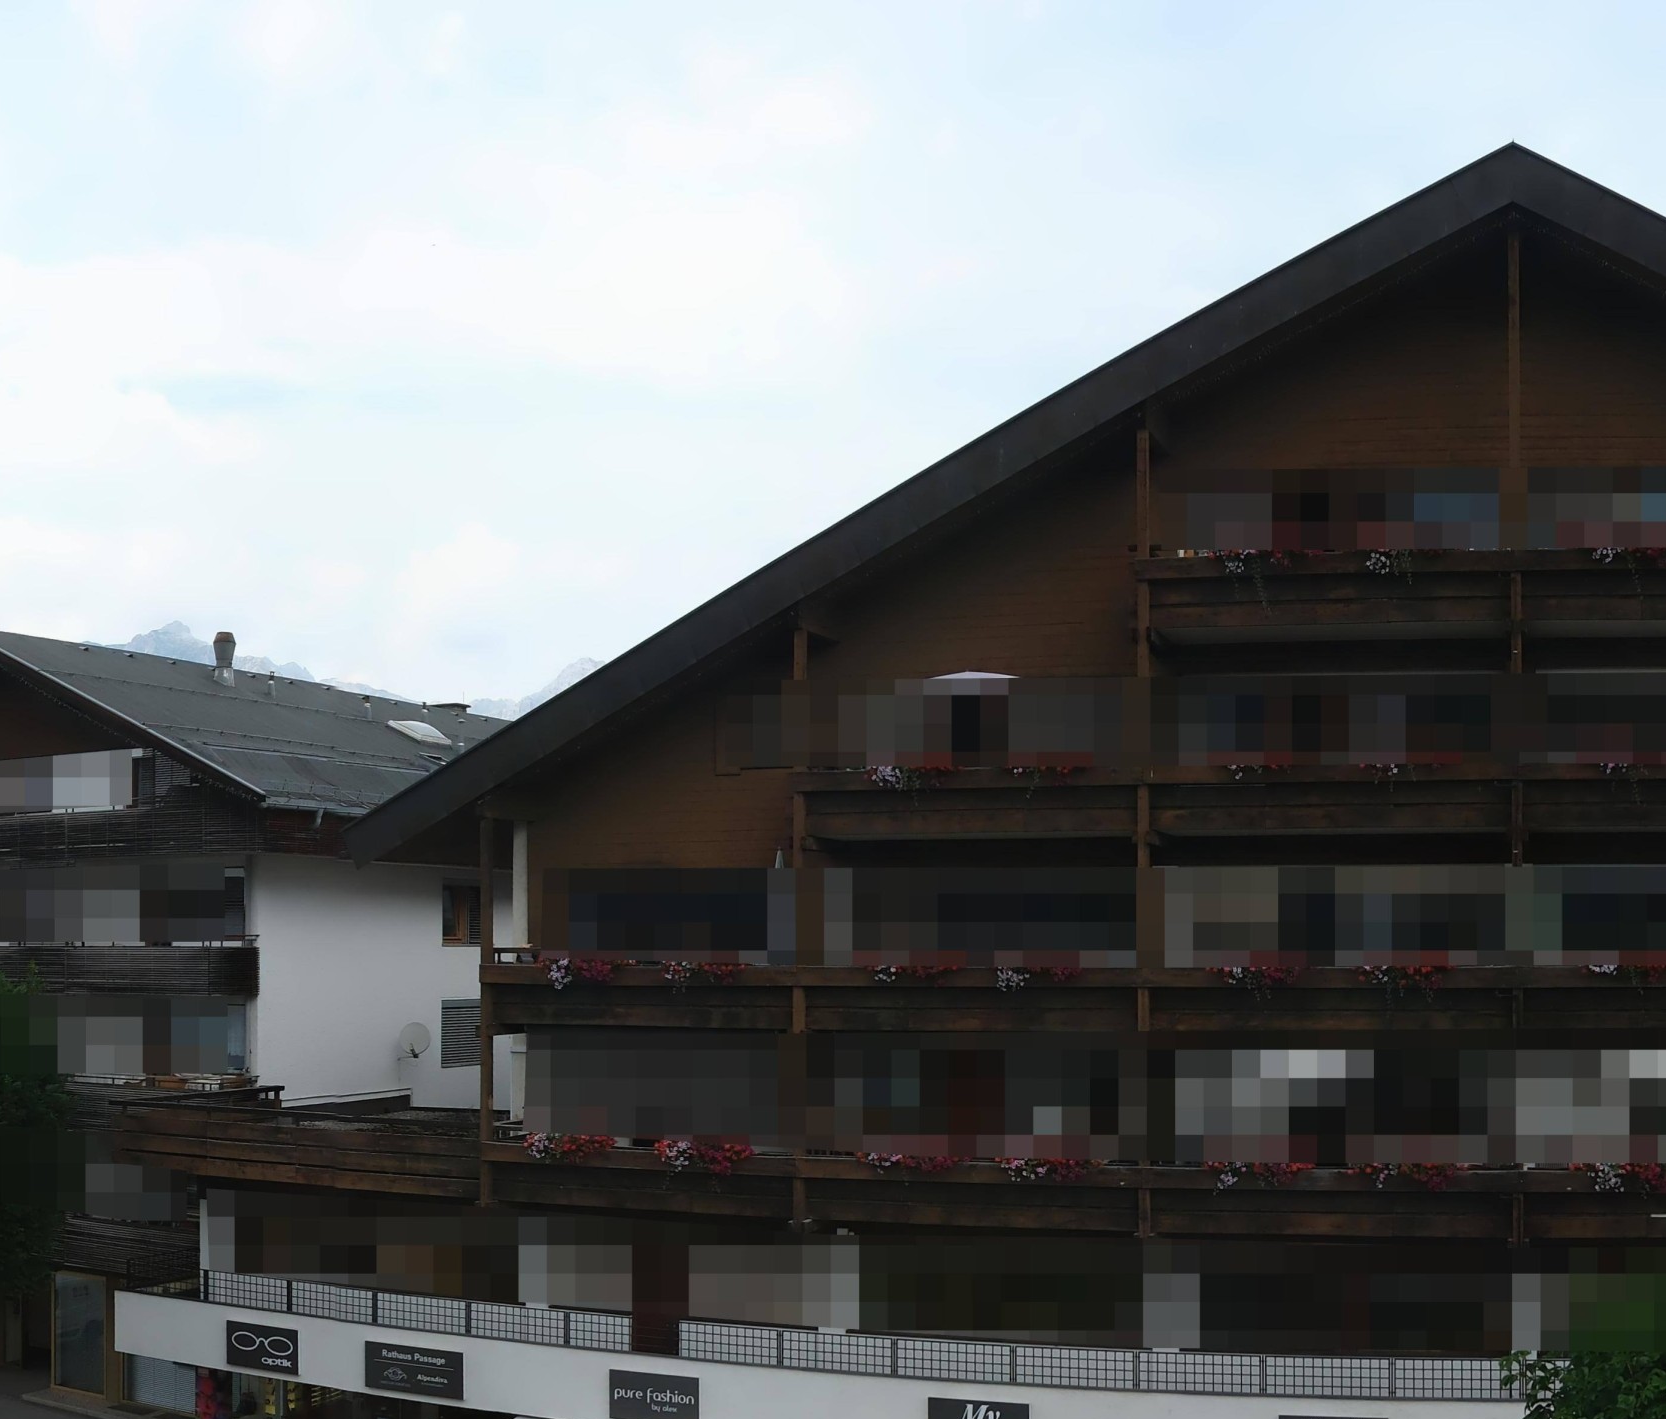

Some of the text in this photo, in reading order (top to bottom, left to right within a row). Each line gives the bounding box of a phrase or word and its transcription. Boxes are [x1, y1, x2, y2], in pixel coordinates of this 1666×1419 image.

[261, 1357, 292, 1368] optik
[382, 1349, 446, 1366] Rathaus Passage
[614, 1387, 695, 1405] pure fashion
[651, 1403, 661, 1413] by
